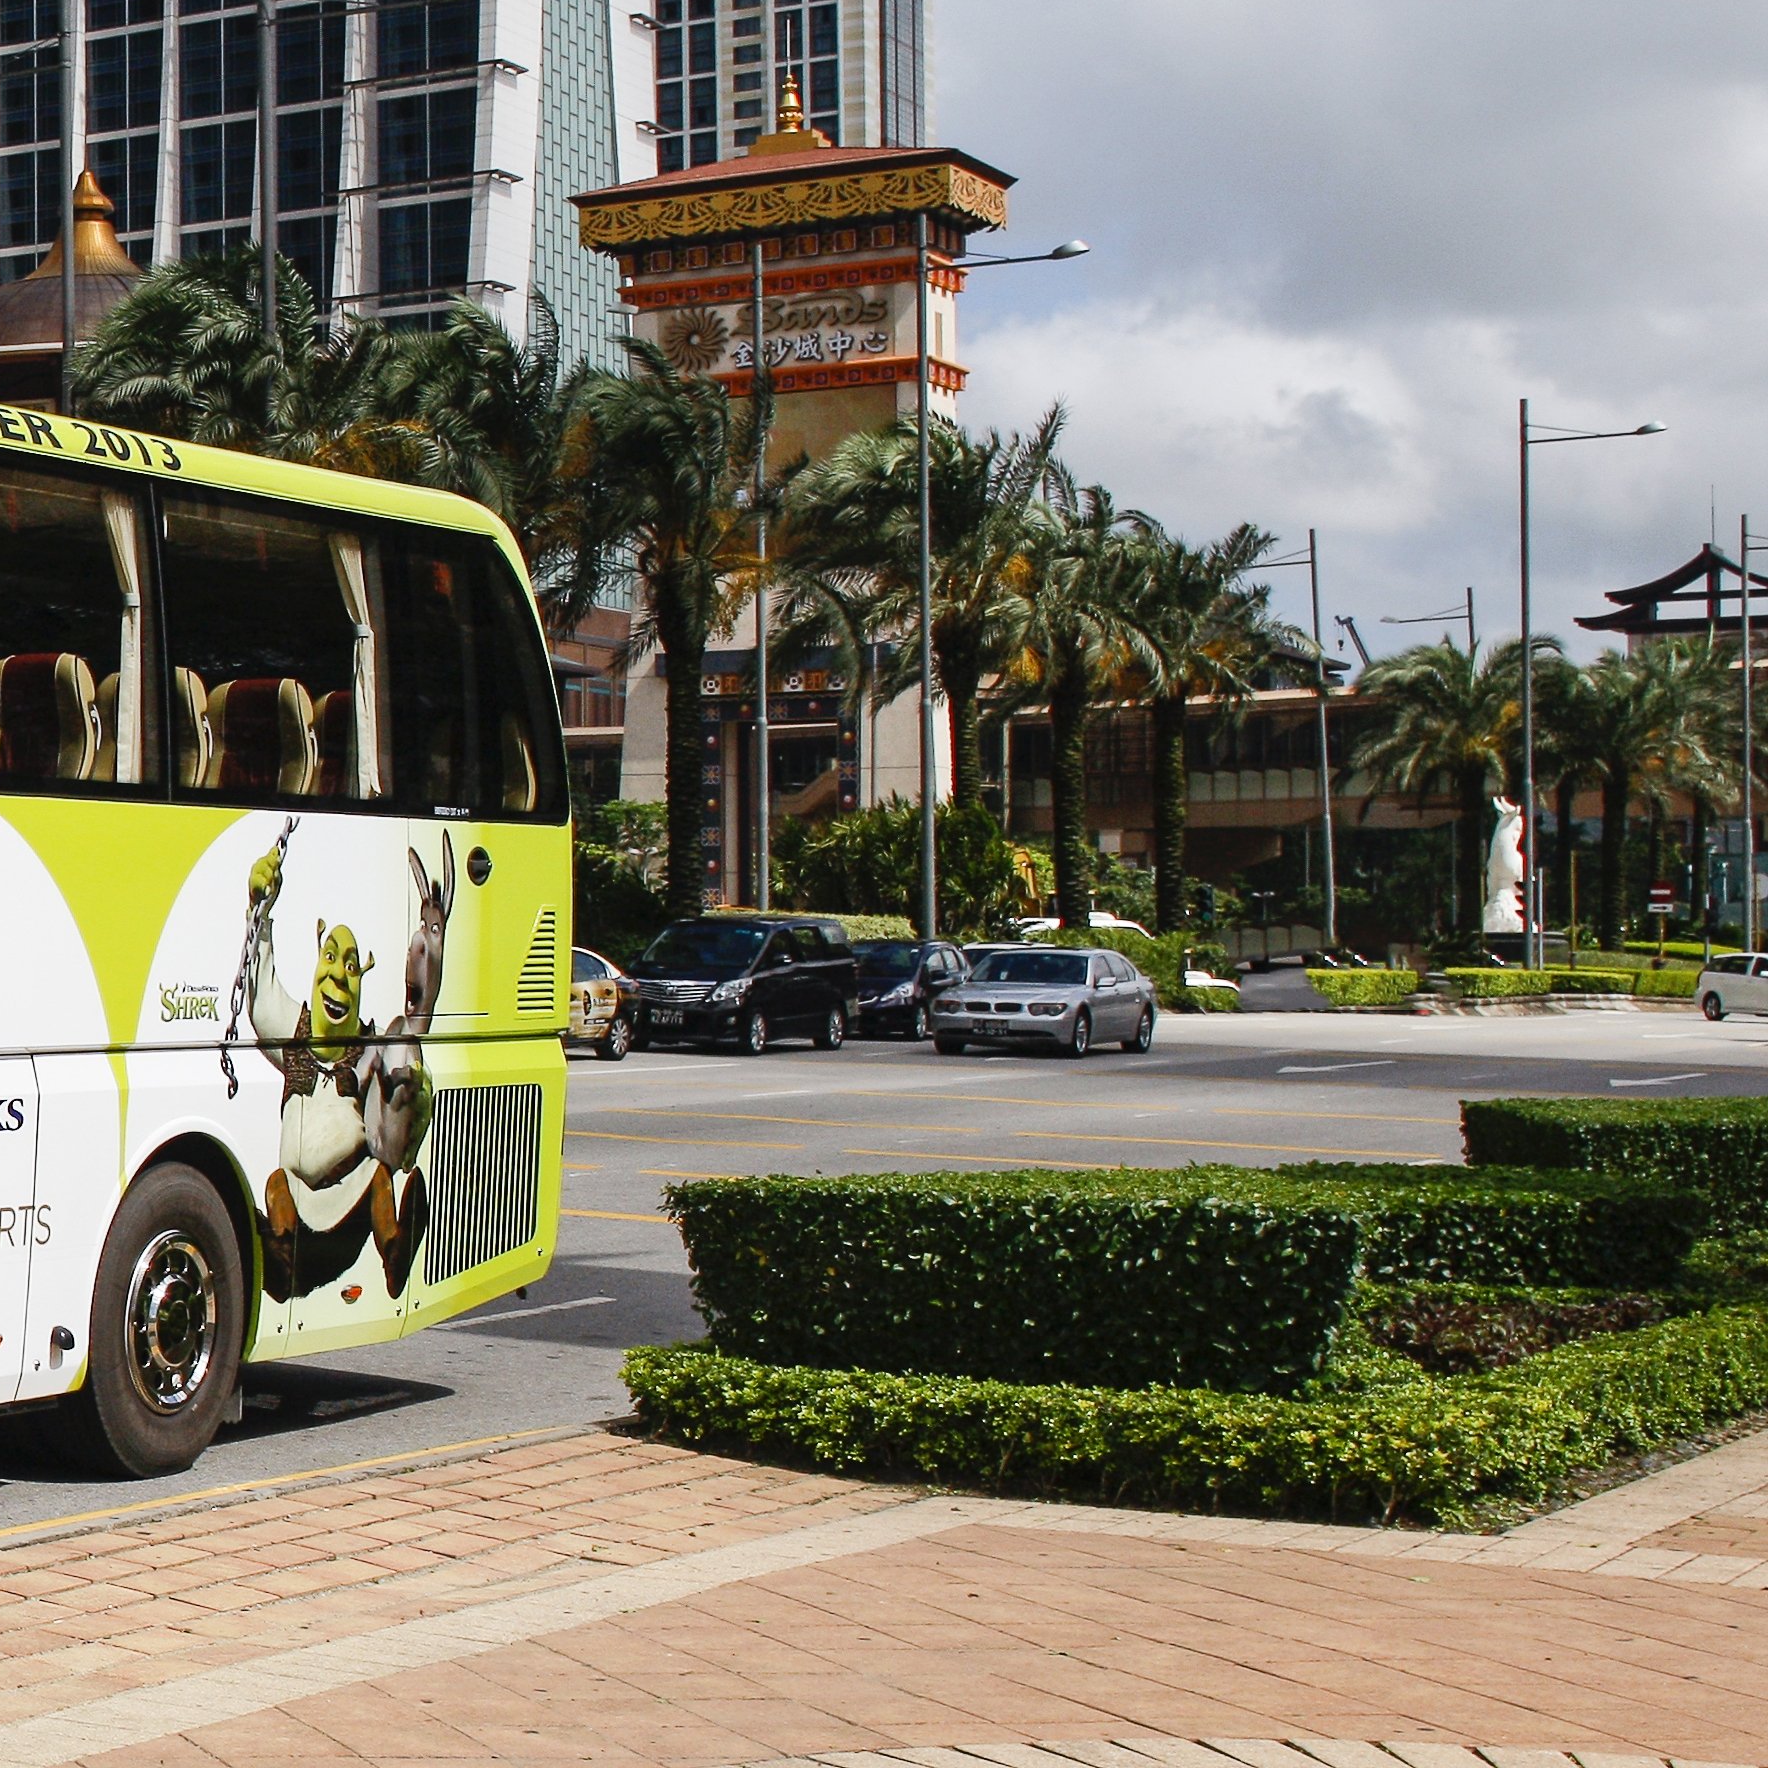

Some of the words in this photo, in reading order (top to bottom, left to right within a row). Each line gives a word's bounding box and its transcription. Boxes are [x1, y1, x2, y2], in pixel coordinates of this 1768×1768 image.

[731, 330, 889, 369] 金沙城中心
[71, 422, 182, 472] 2013
